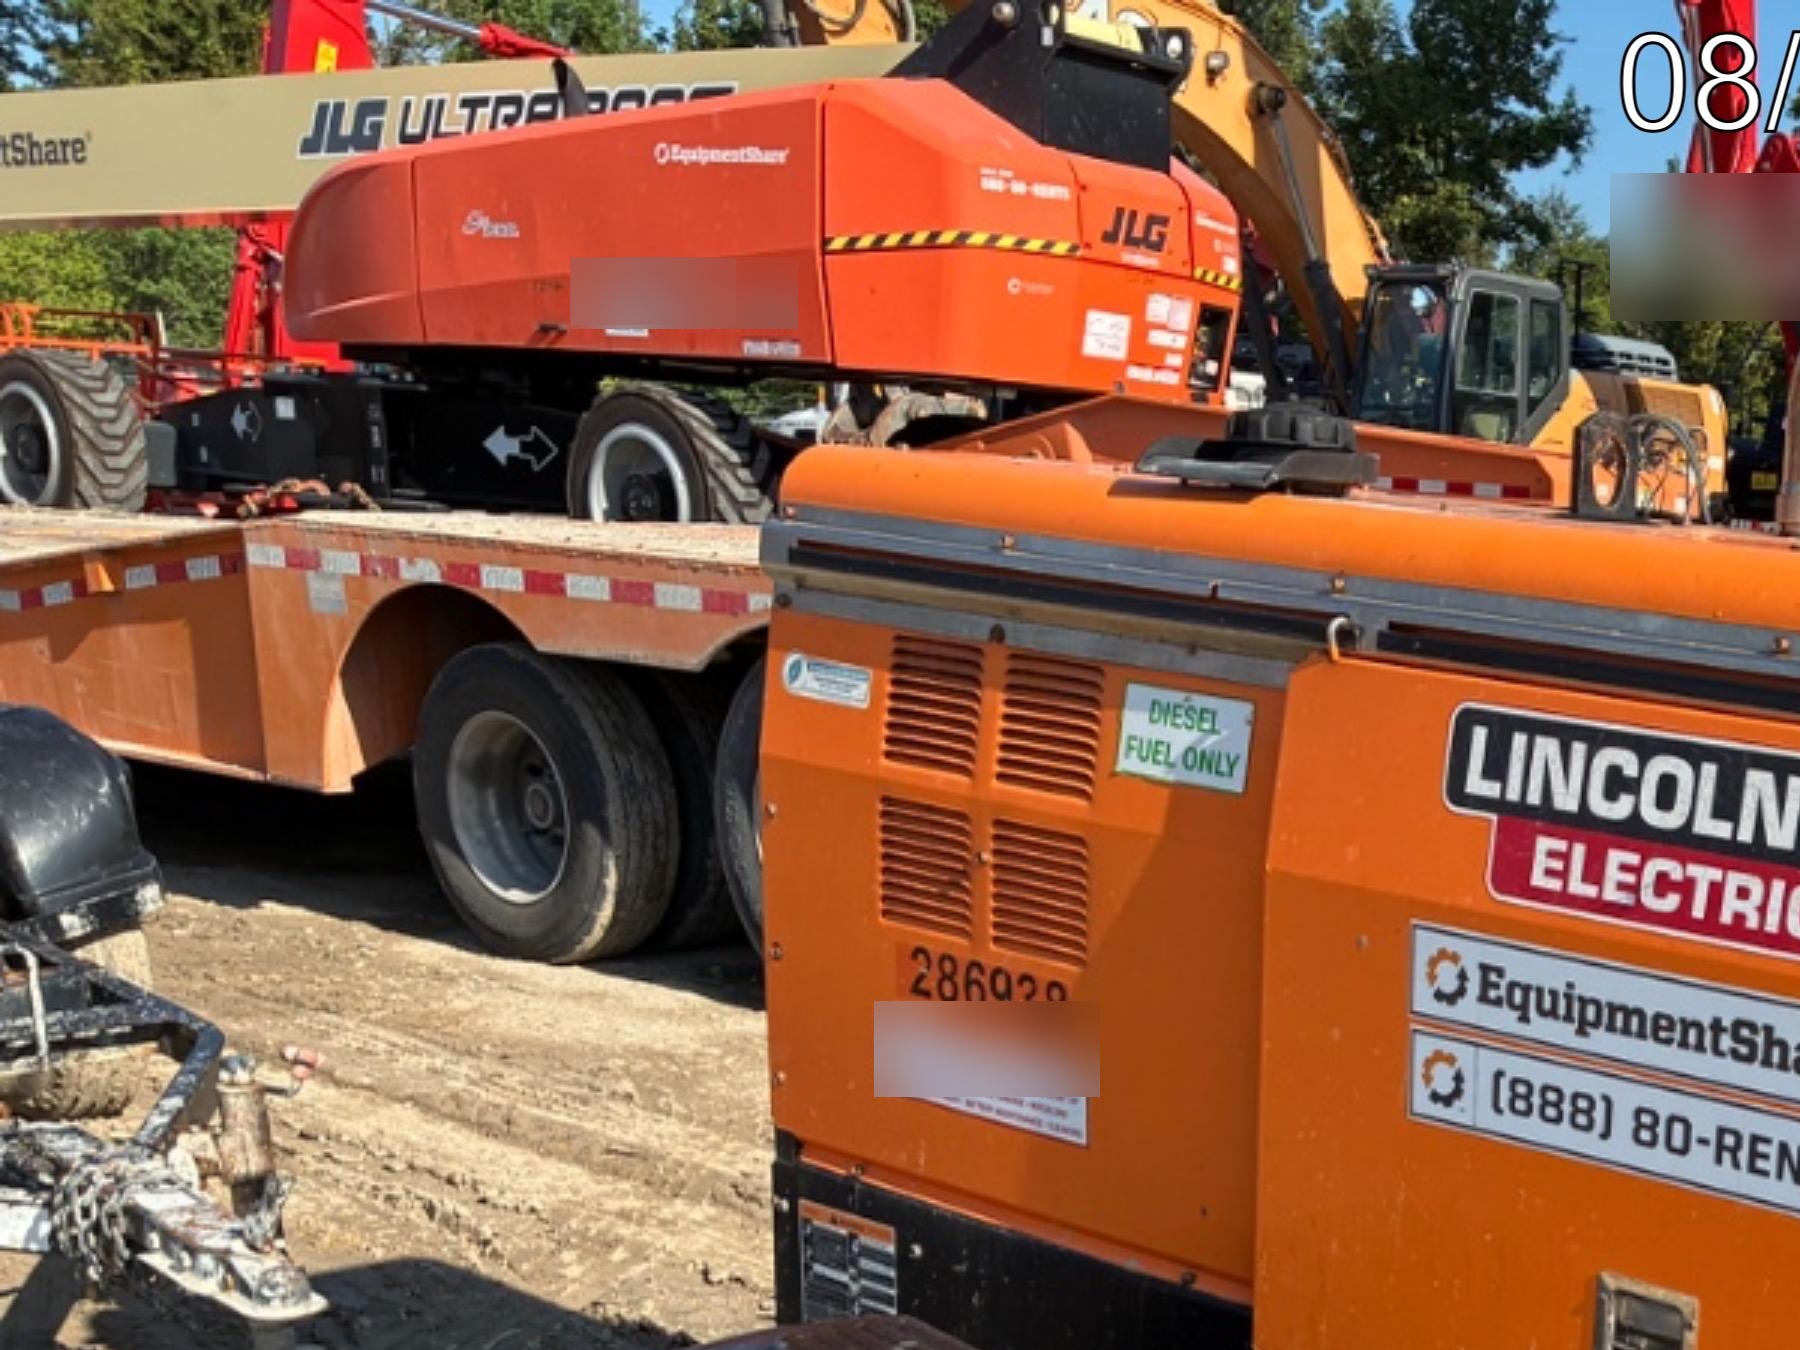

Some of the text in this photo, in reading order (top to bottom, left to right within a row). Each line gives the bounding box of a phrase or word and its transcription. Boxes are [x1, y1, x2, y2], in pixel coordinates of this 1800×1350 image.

[297, 97, 390, 156] JLG
[1101, 207, 1170, 252] JLG
[1148, 698, 1220, 735] DIESEL
[1125, 734, 1240, 778] FUEL ONLY
[1490, 1069, 1613, 1141] (888)
